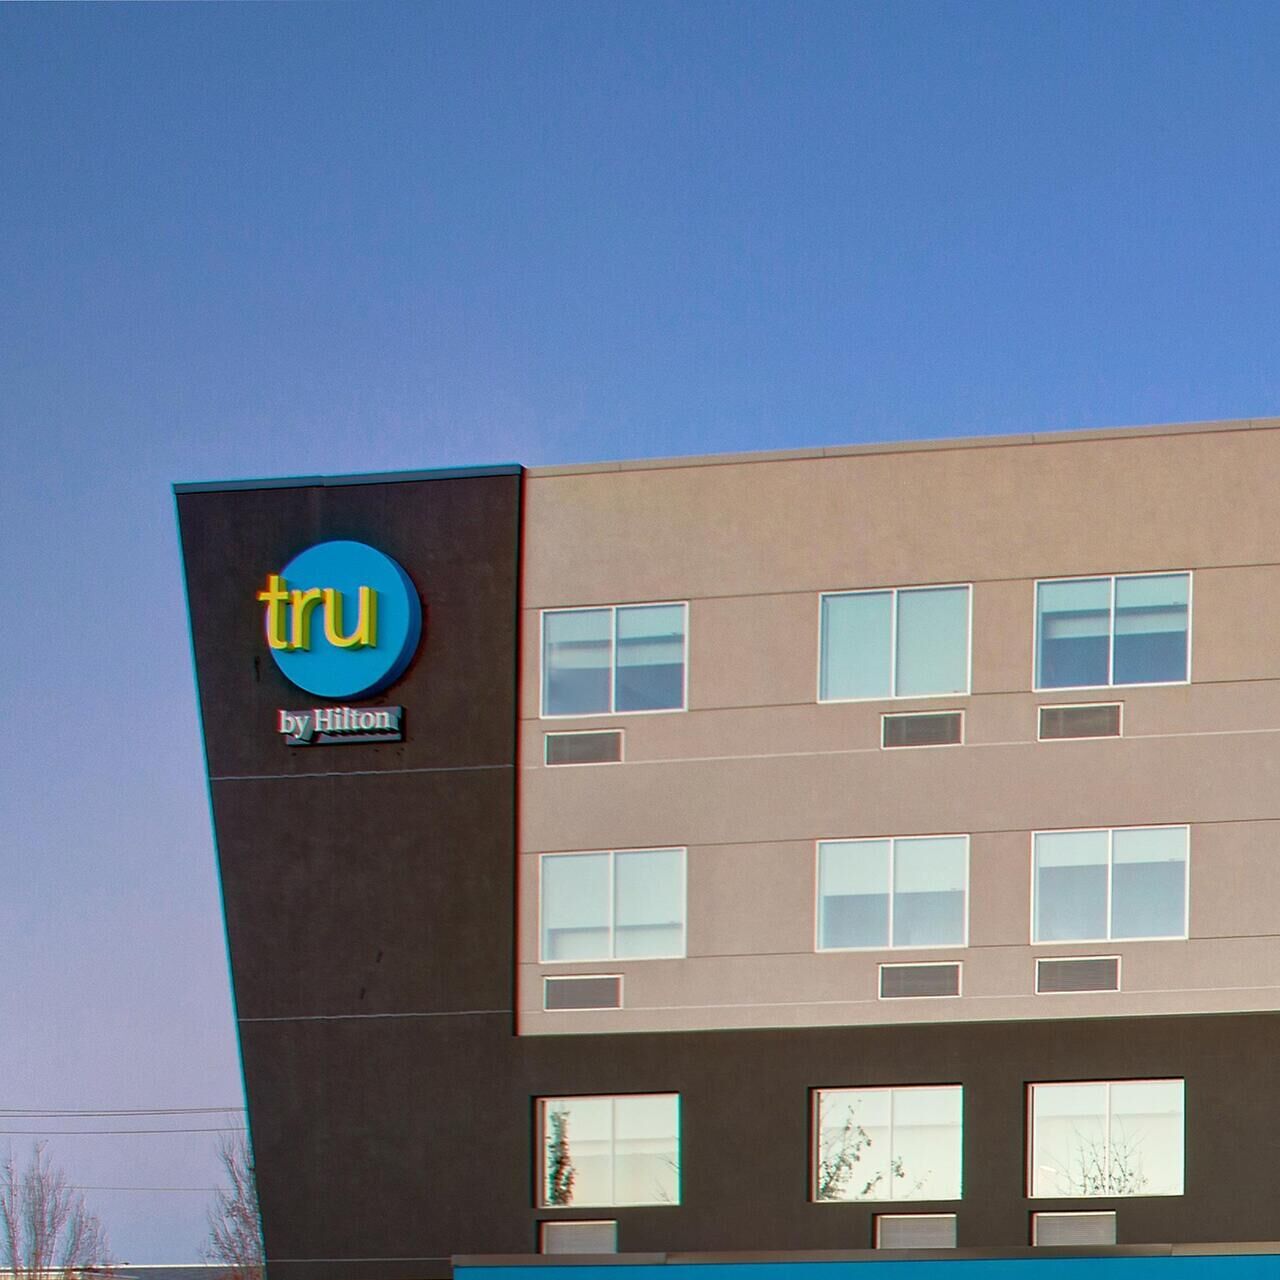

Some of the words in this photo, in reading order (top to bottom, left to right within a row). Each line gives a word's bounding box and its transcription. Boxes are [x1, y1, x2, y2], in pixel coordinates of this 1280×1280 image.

[257, 574, 377, 651] tru
[279, 709, 311, 739] by
[314, 706, 391, 732] Hilton
